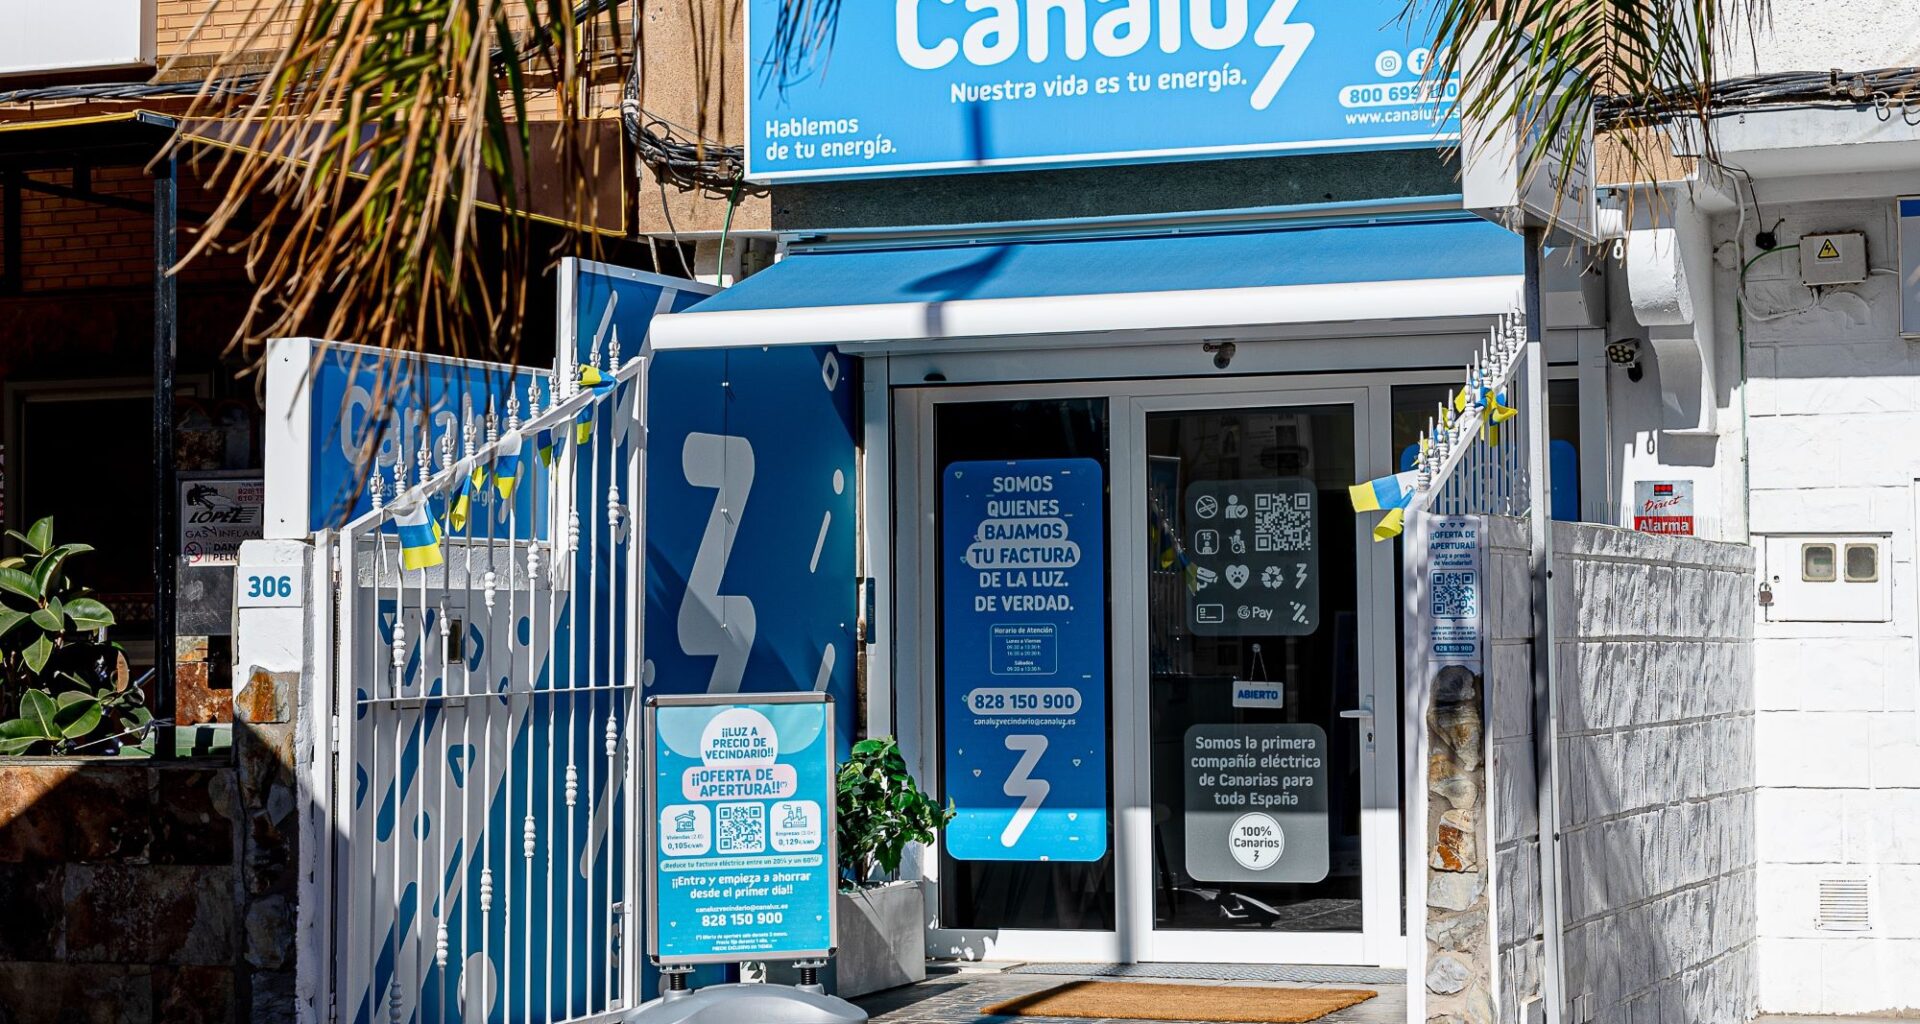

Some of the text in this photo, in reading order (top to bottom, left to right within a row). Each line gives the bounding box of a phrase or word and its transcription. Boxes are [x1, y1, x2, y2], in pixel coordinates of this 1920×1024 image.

[951, 62, 1248, 104] Nuestra vida es tu energía.
[1349, 87, 1382, 104] 800
[1388, 85, 1421, 102] 699
[765, 117, 859, 139] Hablemos
[766, 133, 897, 161] de tu energía.
[993, 475, 1053, 493] SOMOS
[987, 500, 1060, 517] QUIENES
[984, 523, 1063, 540] BAJAMOS
[1639, 518, 1690, 532] Alarma
[185, 530, 209, 538] GAS
[1201, 532, 1212, 540] 15
[1465, 530, 1475, 538] DE
[972, 547, 1076, 564] TU FACTURA
[248, 575, 292, 598] 306
[979, 571, 1069, 588] DE LA LUZ.
[975, 595, 1074, 612] DE VERDAD.
[1252, 606, 1274, 621] Pay
[1027, 626, 1053, 634] Atención
[974, 694, 1075, 709] 828 150 900
[1237, 689, 1279, 700] ABIERTO
[974, 717, 1076, 728] canaluzvecindario@canaluz.es
[722, 727, 758, 738] ¡¡LUZ A
[713, 737, 767, 748] PRECIO DE
[1195, 736, 1316, 752] Somos la primera
[705, 747, 774, 759] VECINDARIO!!
[1191, 753, 1321, 771] compañía eléctrica
[692, 768, 774, 786] ¡¡OFERTA DE
[1199, 773, 1314, 790] de Canarias para
[1214, 792, 1299, 808] toda España
[1240, 826, 1272, 837] 100%
[1234, 837, 1280, 848] Canarios
[672, 875, 705, 888] ¡¡Entra
[709, 876, 716, 886] y
[719, 873, 760, 888] empieza
[773, 872, 811, 882] ahorrar
[690, 885, 793, 899] desde el primer día!!
[702, 912, 783, 927] 828 150 900
